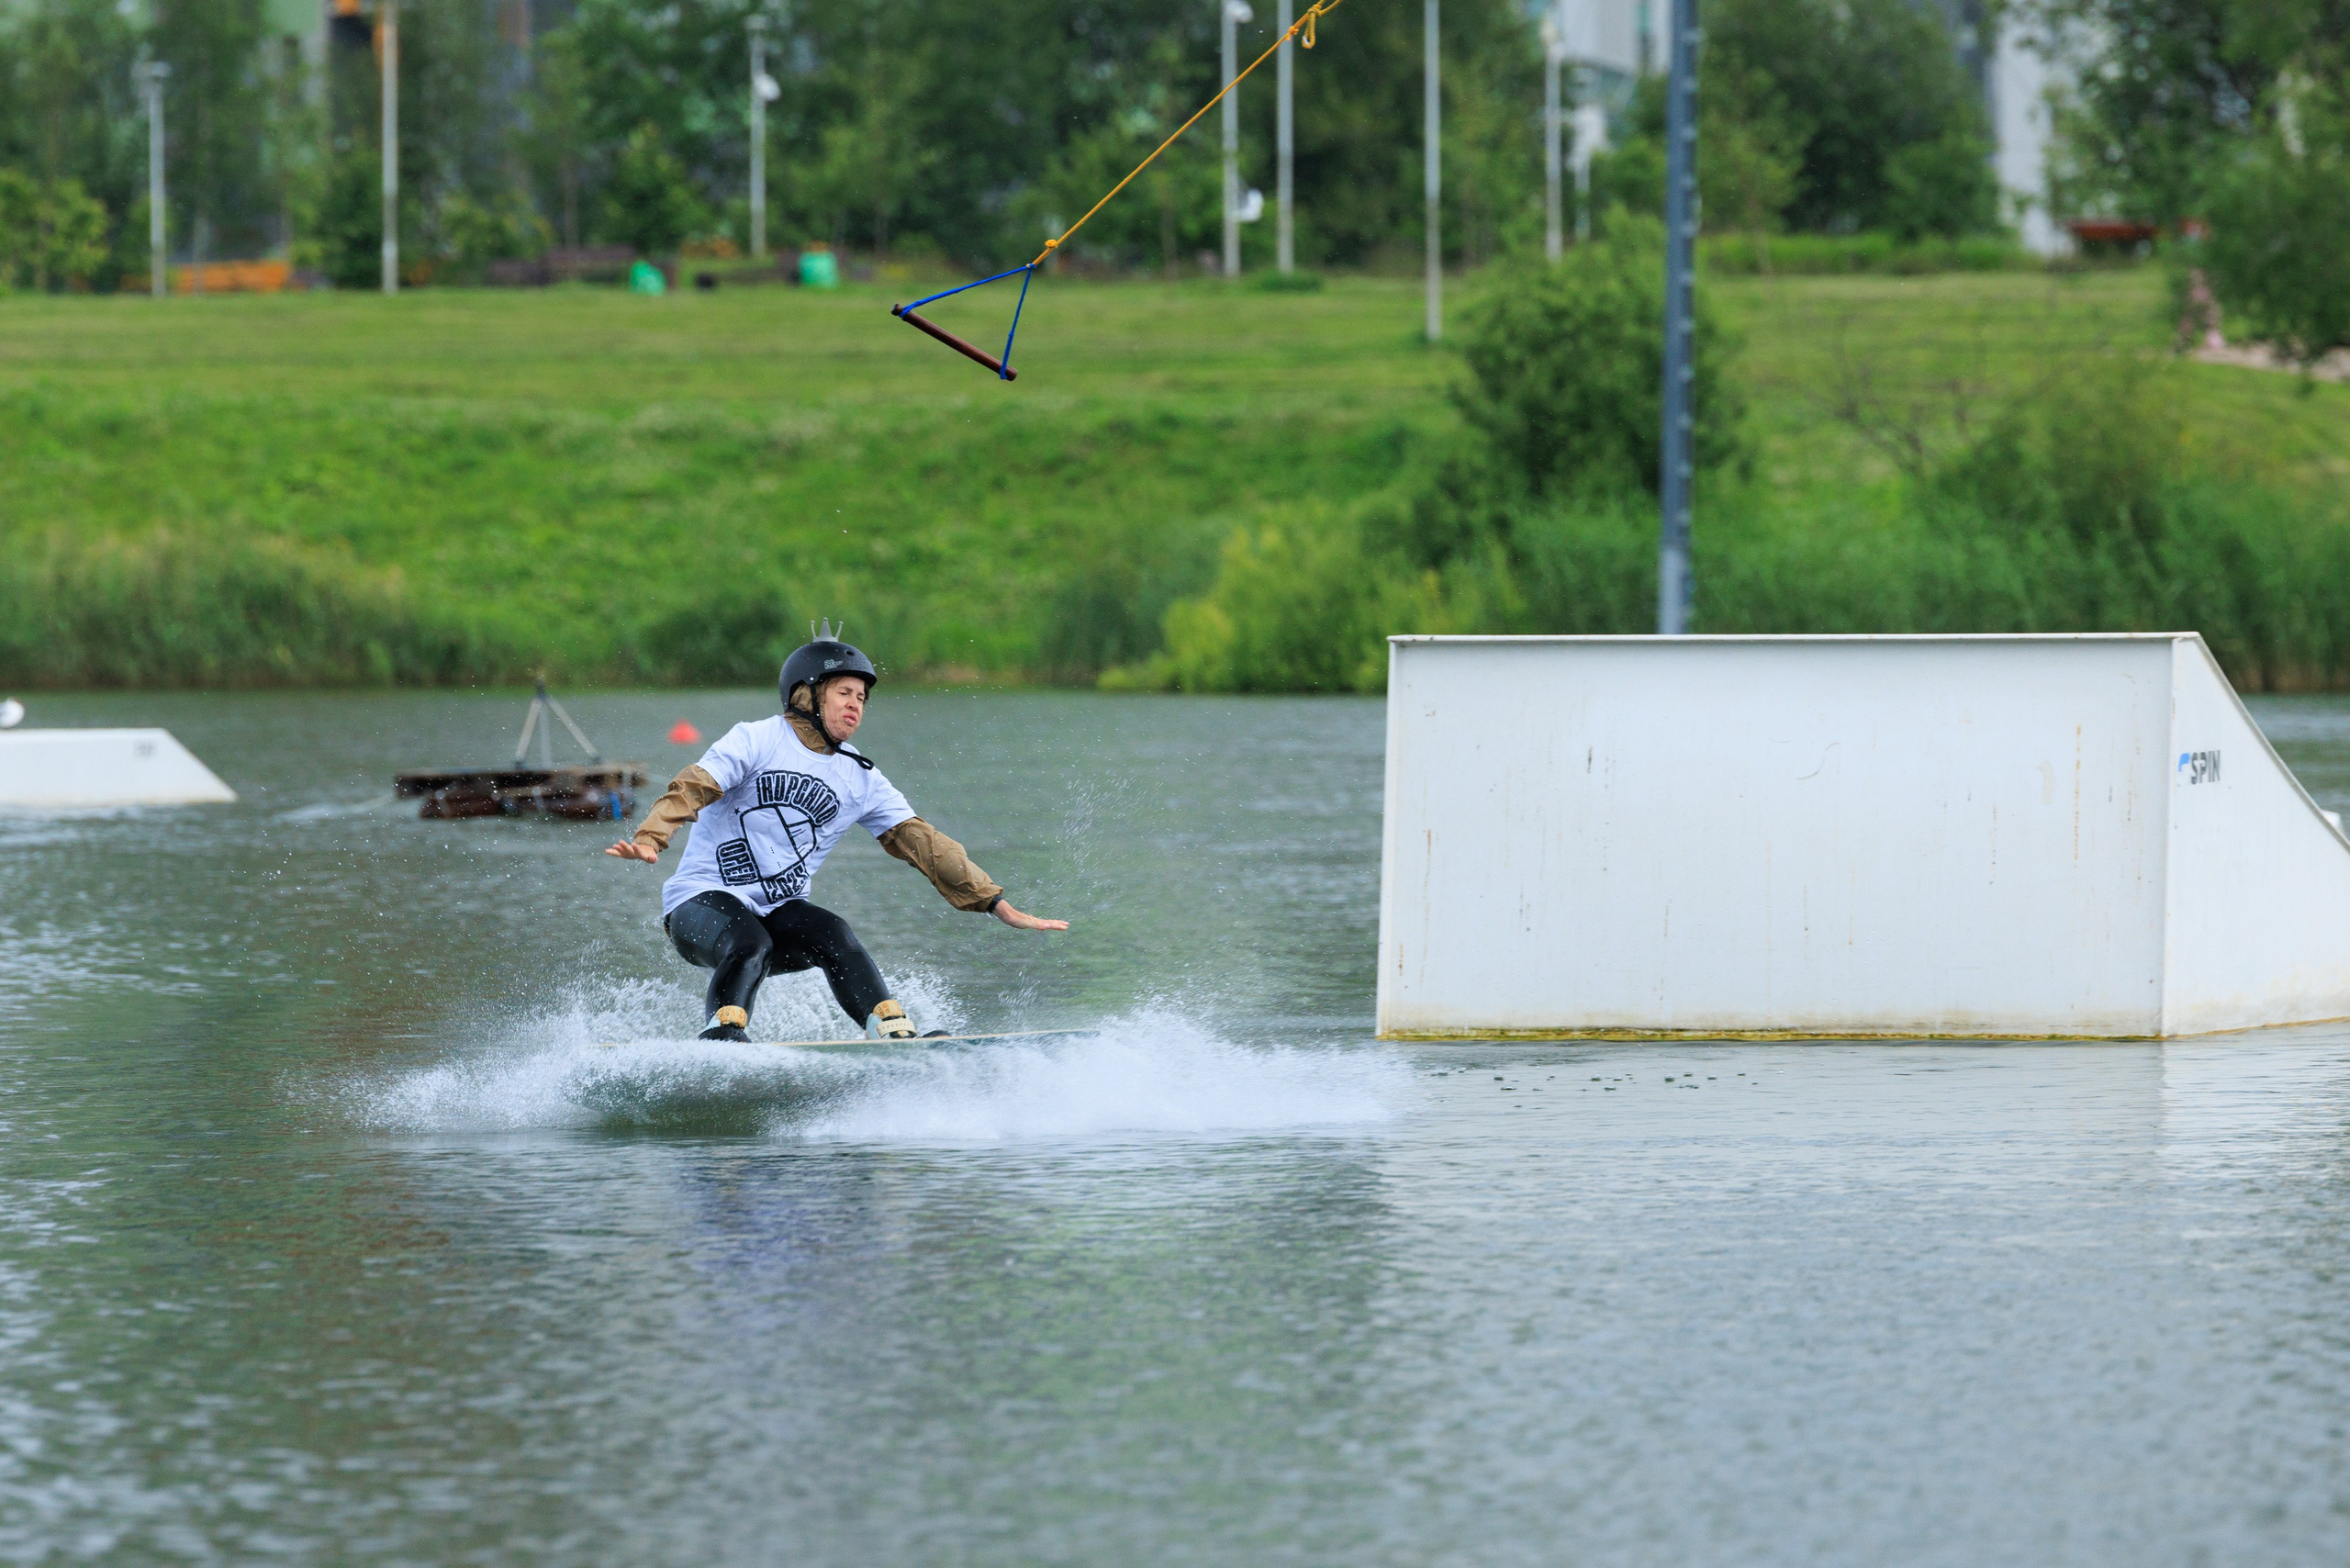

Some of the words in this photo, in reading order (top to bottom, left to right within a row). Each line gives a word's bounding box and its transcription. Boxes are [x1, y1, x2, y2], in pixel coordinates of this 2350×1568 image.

[2190, 750, 2221, 785] SPIN
[719, 841, 757, 883] OPEN
[764, 863, 809, 903] 2025
